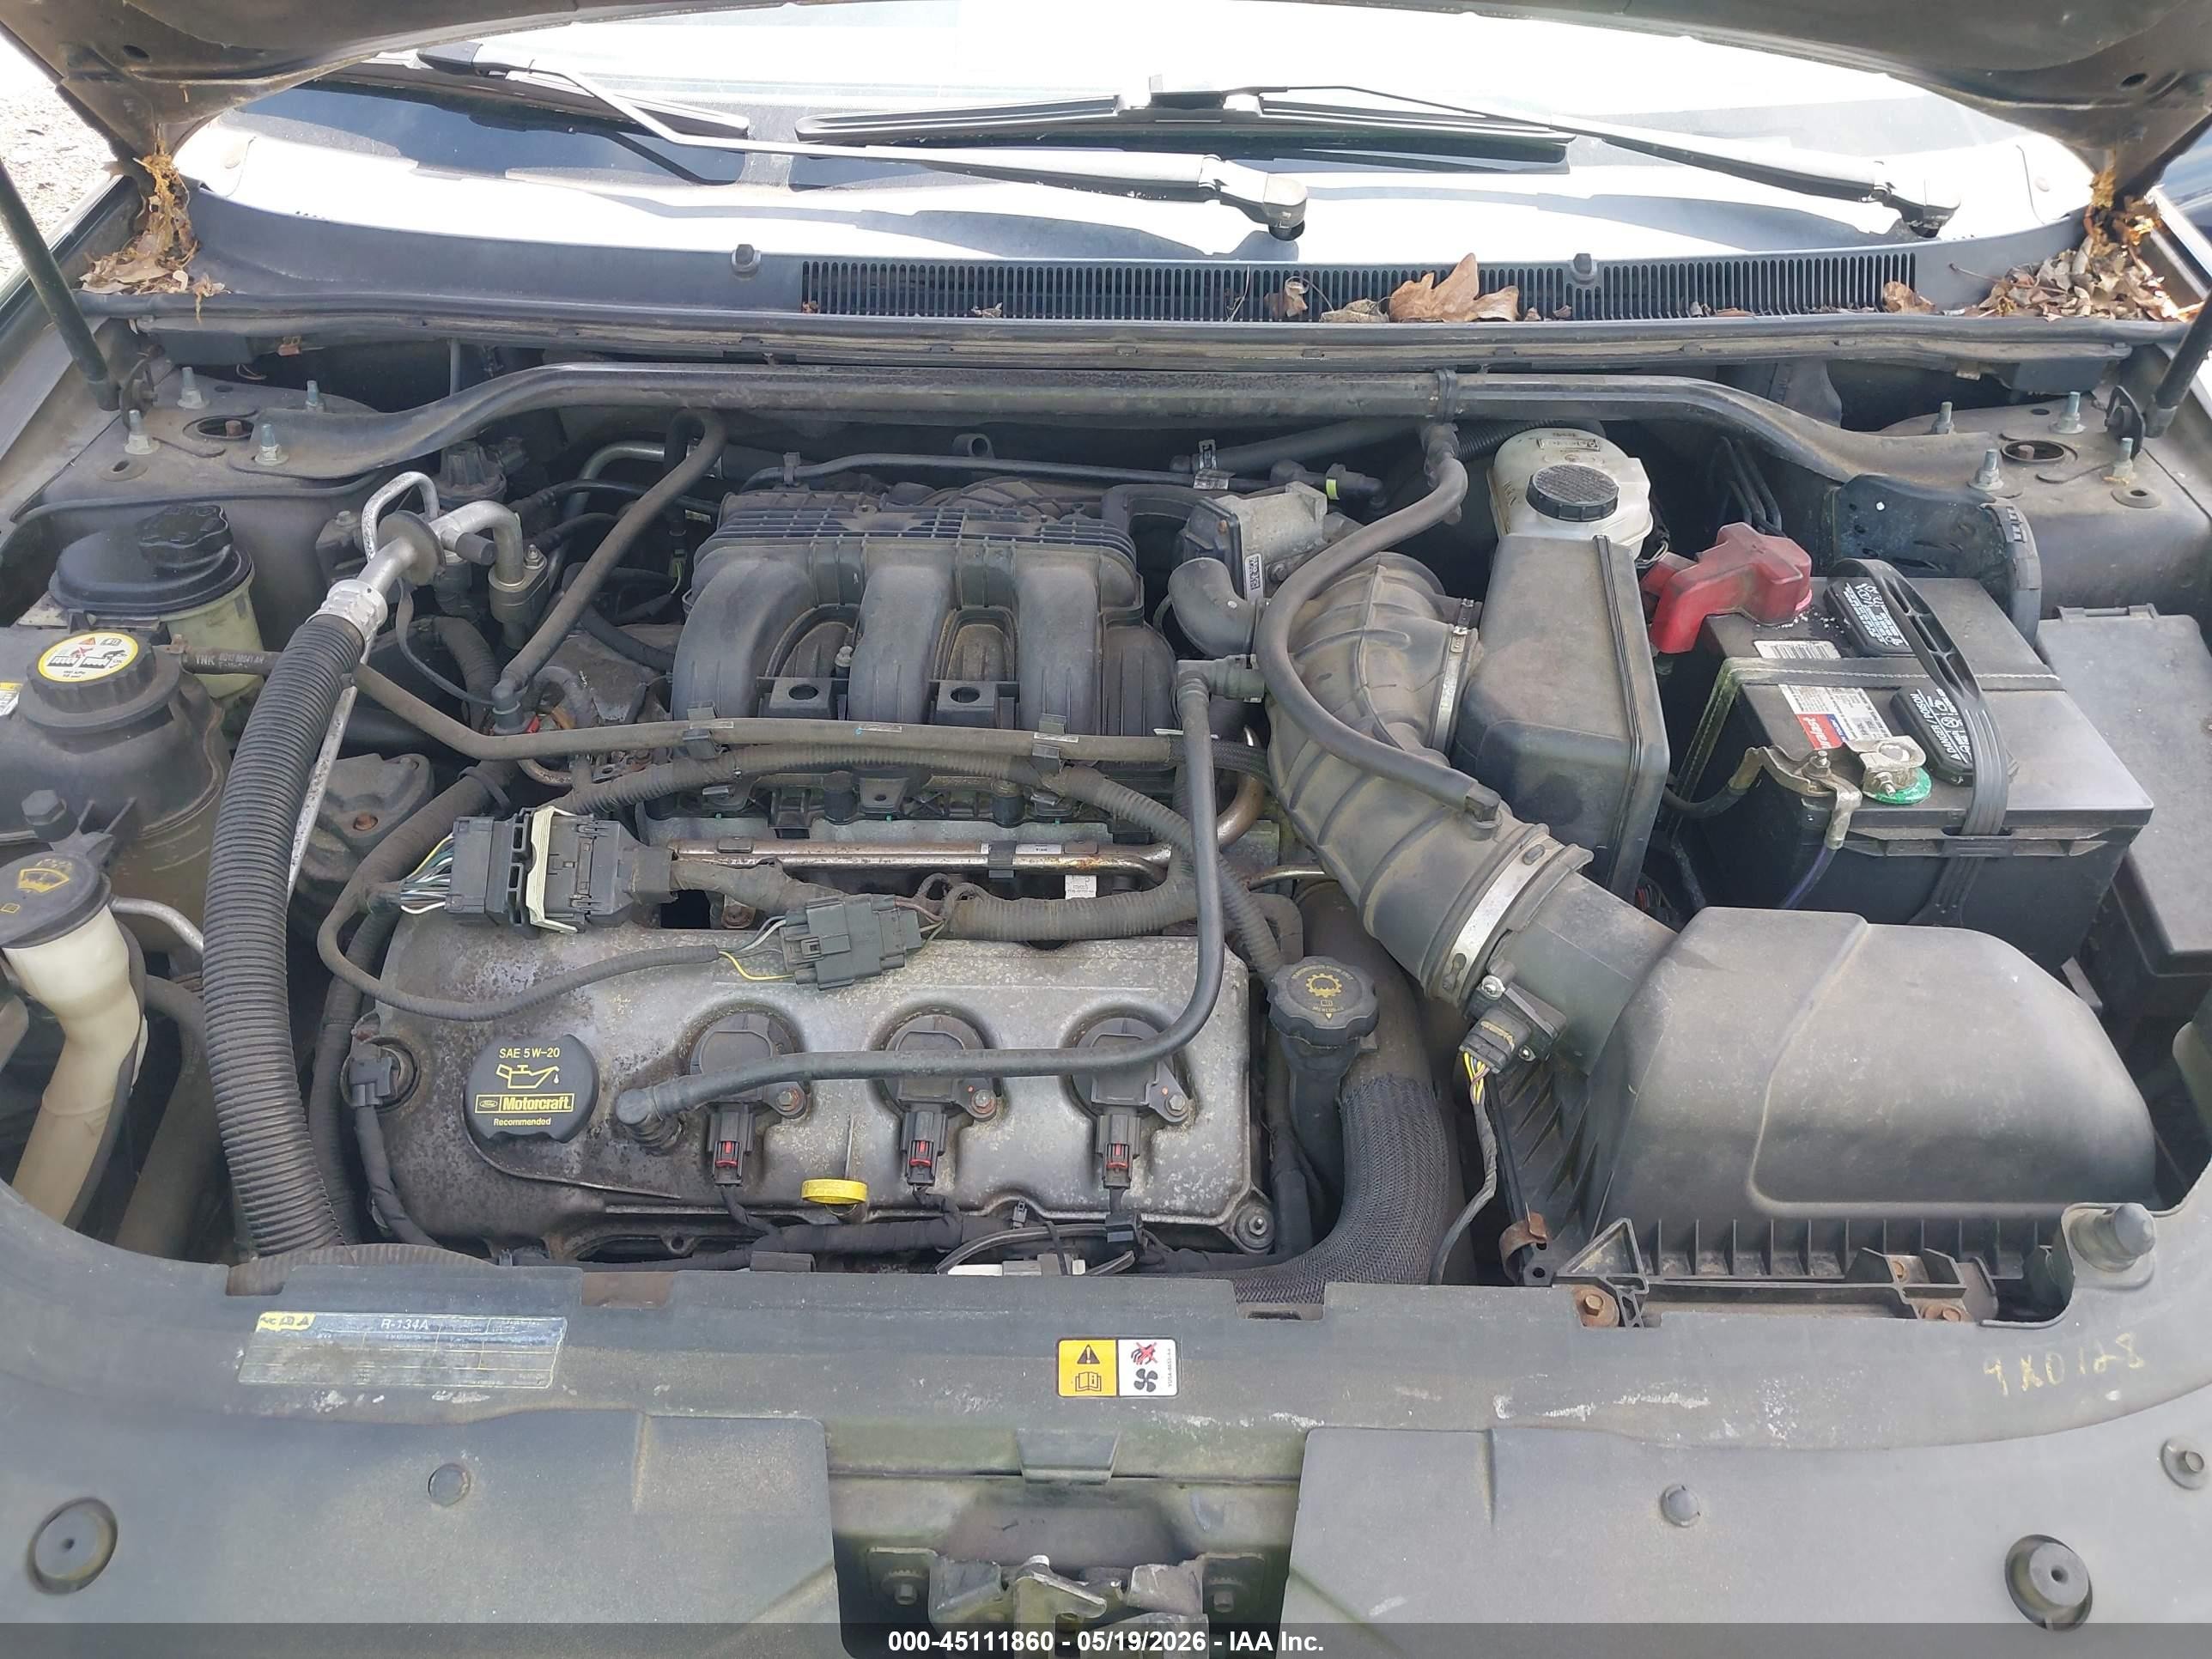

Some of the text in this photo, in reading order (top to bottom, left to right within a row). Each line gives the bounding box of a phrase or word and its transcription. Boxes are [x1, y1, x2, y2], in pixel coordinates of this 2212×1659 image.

[1909, 693, 1934, 719] POISON
[1802, 716, 1832, 750] uralast
[1930, 725, 1959, 753] DANGER
[498, 1048, 520, 1059] SAE
[493, 1117, 551, 1127] Recommended
[380, 1318, 429, 1330] R-134A
